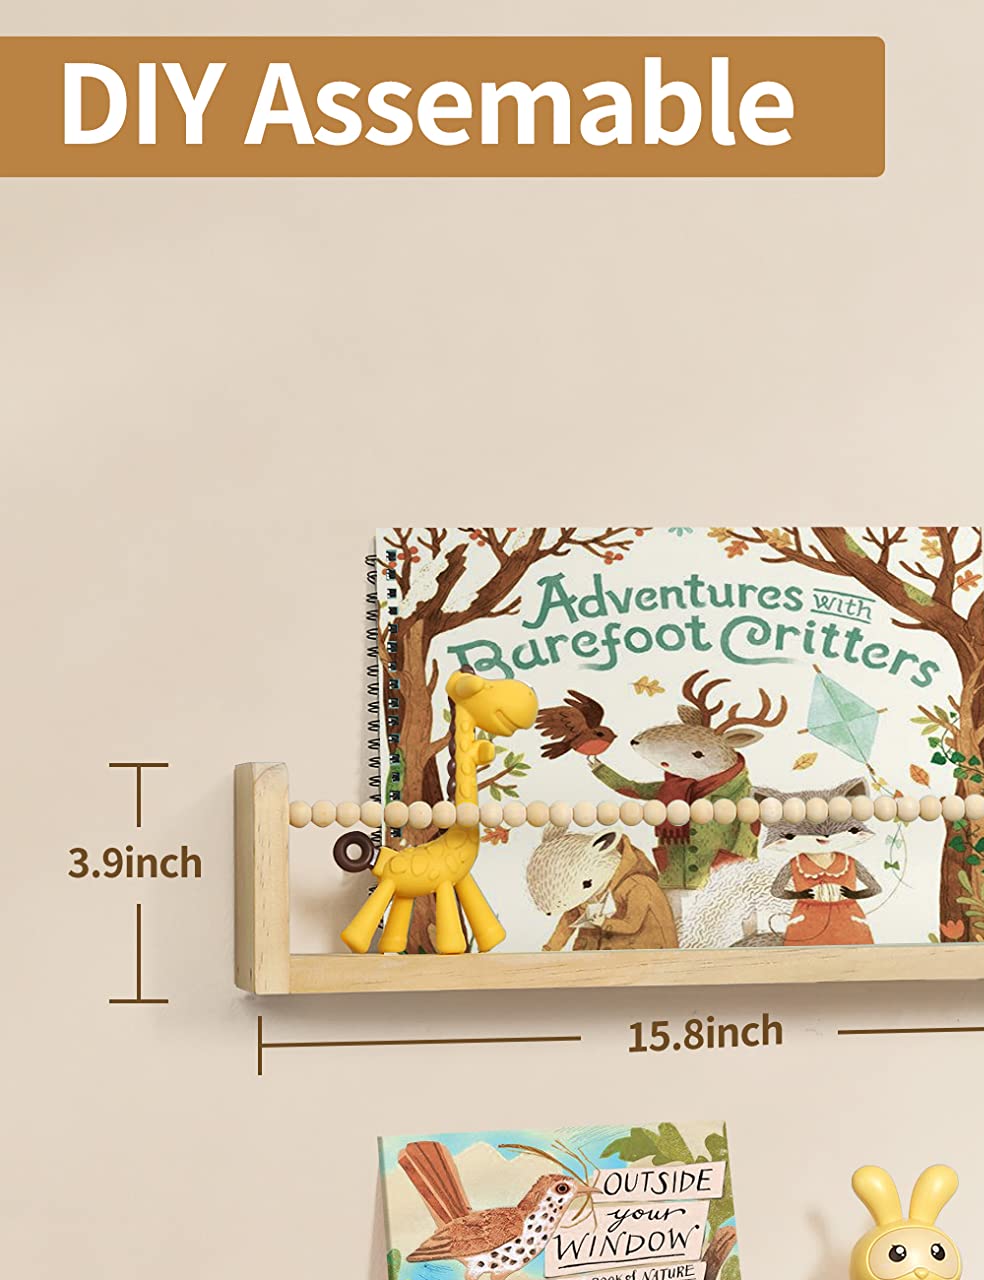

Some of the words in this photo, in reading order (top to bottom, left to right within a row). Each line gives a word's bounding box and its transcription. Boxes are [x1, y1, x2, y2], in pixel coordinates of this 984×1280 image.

[521, 571, 804, 630] Adventures
[446, 614, 713, 681] Barefoot
[720, 614, 941, 689] Critters
[603, 1168, 714, 1196] OUTSIDE
[607, 1207, 687, 1233] your
[553, 1224, 701, 1261] WINDOW
